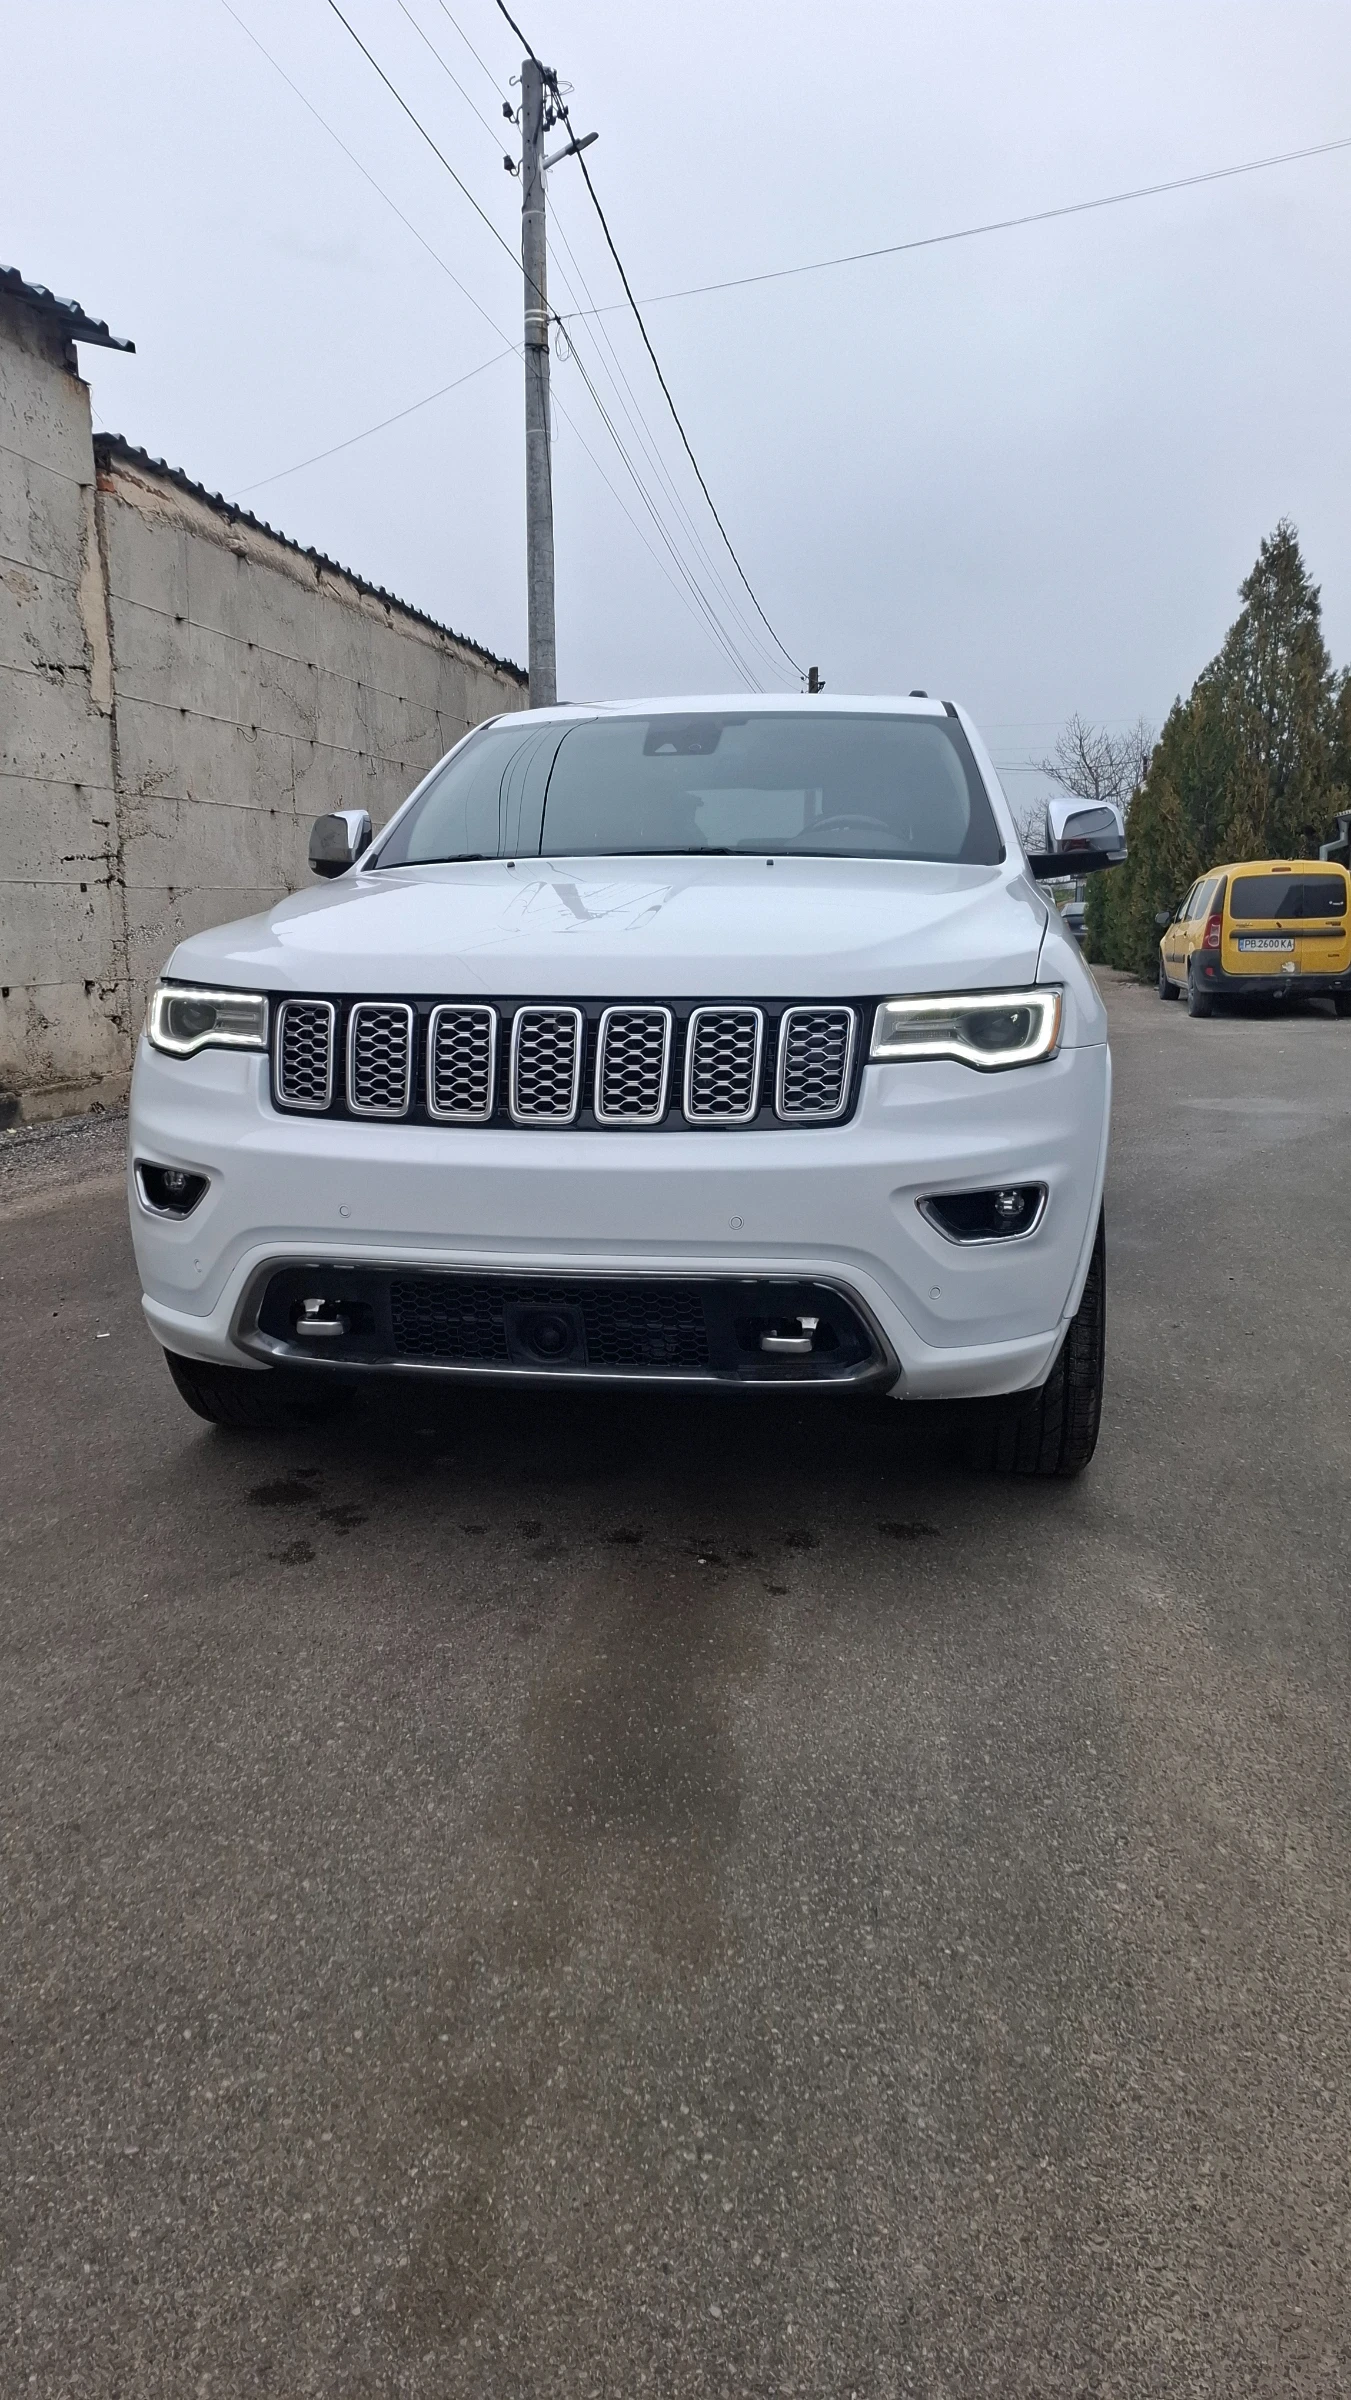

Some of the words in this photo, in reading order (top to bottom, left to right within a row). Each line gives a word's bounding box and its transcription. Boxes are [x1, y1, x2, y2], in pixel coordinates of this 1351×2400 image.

[1244, 940, 1256, 948] PB
[1258, 940, 1279, 948] 2600
[1280, 940, 1292, 948] KA
